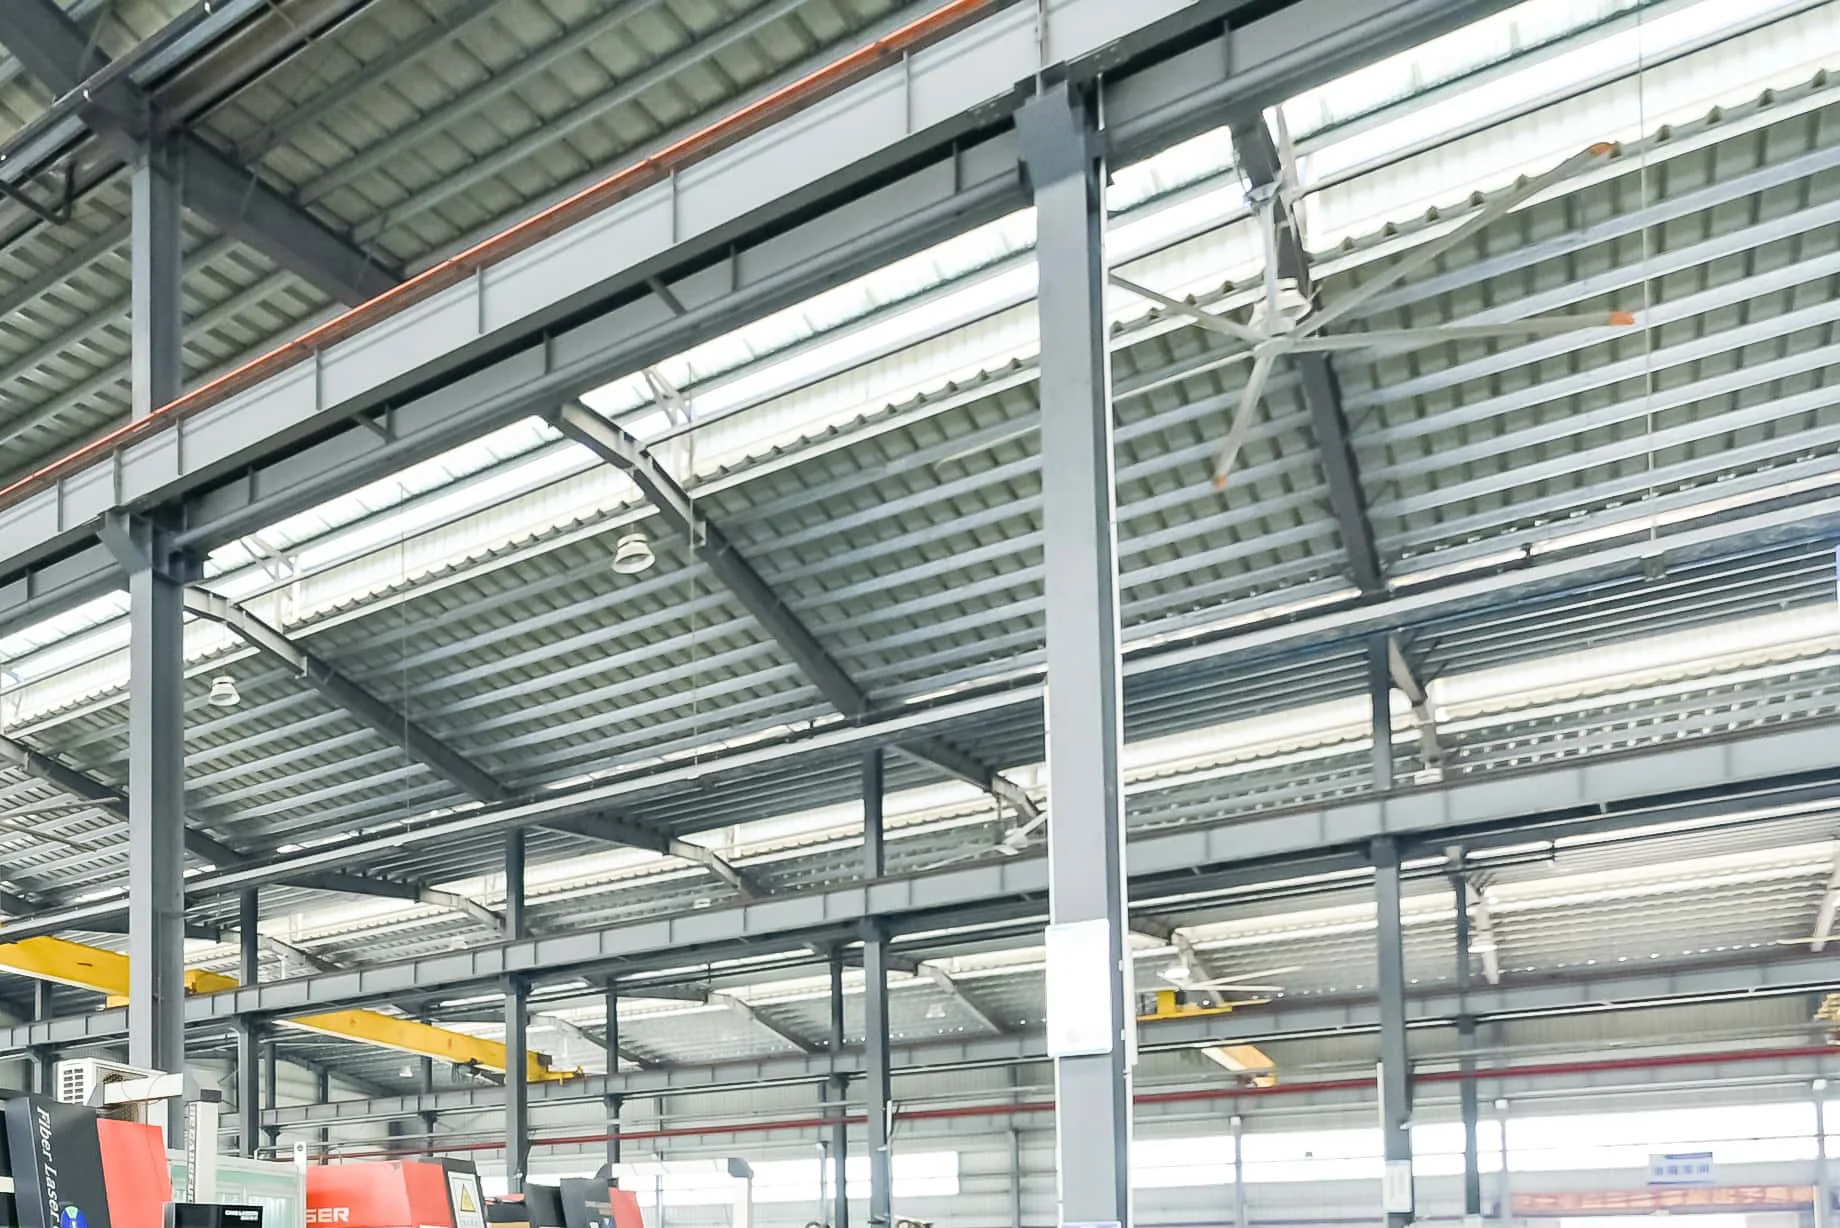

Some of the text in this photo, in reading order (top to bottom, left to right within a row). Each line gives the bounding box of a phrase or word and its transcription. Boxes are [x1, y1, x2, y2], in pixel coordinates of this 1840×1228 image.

[36, 1105, 52, 1162] Fiber
[44, 1162, 60, 1224] Laser
[305, 1207, 350, 1223] SER
